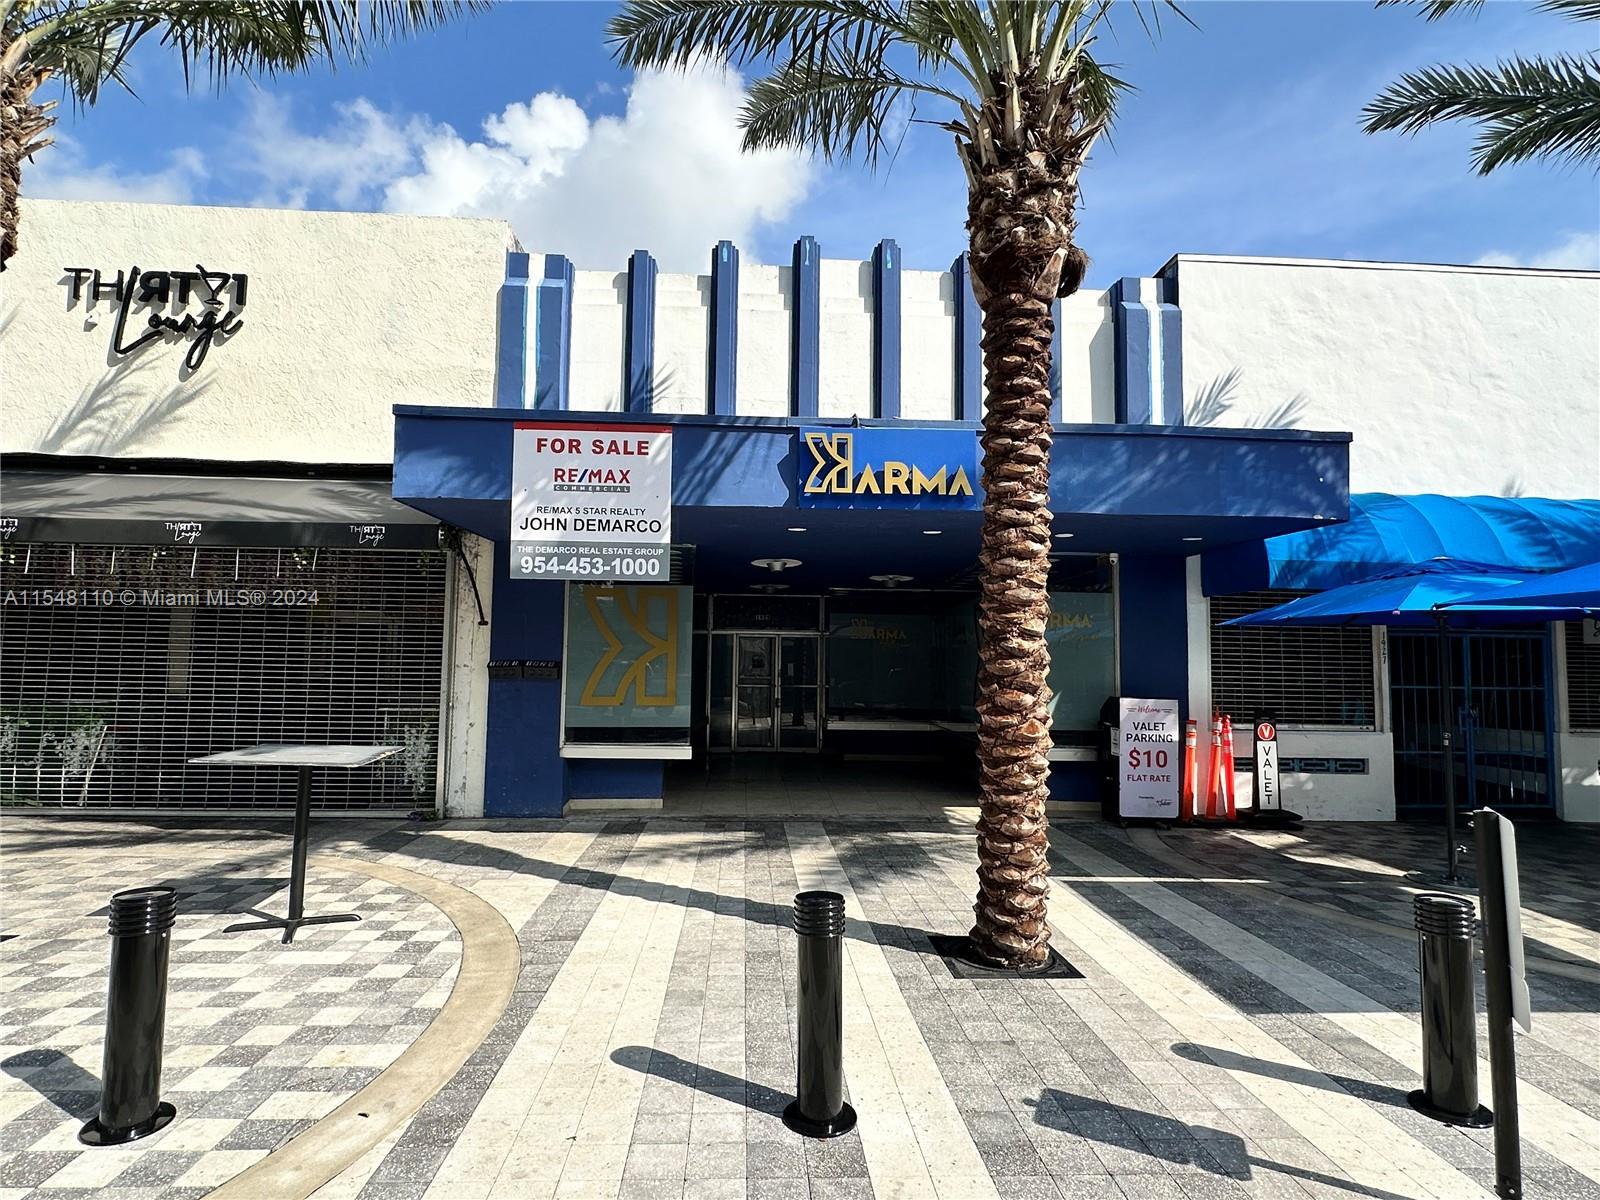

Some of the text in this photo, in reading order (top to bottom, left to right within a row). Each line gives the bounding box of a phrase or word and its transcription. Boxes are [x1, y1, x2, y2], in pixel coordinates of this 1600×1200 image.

[114, 285, 244, 371] Lounge
[536, 438, 649, 456] FOR SALE
[554, 468, 631, 483] RE/MAX
[536, 506, 573, 515] RE/MAX
[610, 508, 646, 516] REALTY
[520, 518, 661, 533] JOHN DEMARCO
[535, 546, 577, 554] DEMARCO
[578, 547, 600, 555] REAL
[602, 547, 633, 556] ESTATE
[634, 548, 664, 556] GROUP
[520, 556, 660, 576] 954-453-1000
[1048, 611, 1093, 629] RMA
[1132, 721, 1167, 731] VALET
[1126, 733, 1173, 743] PARKING
[1128, 746, 1168, 770] $10
[1127, 774, 1171, 783] FLAT RATE
[1262, 745, 1274, 805] VALET
